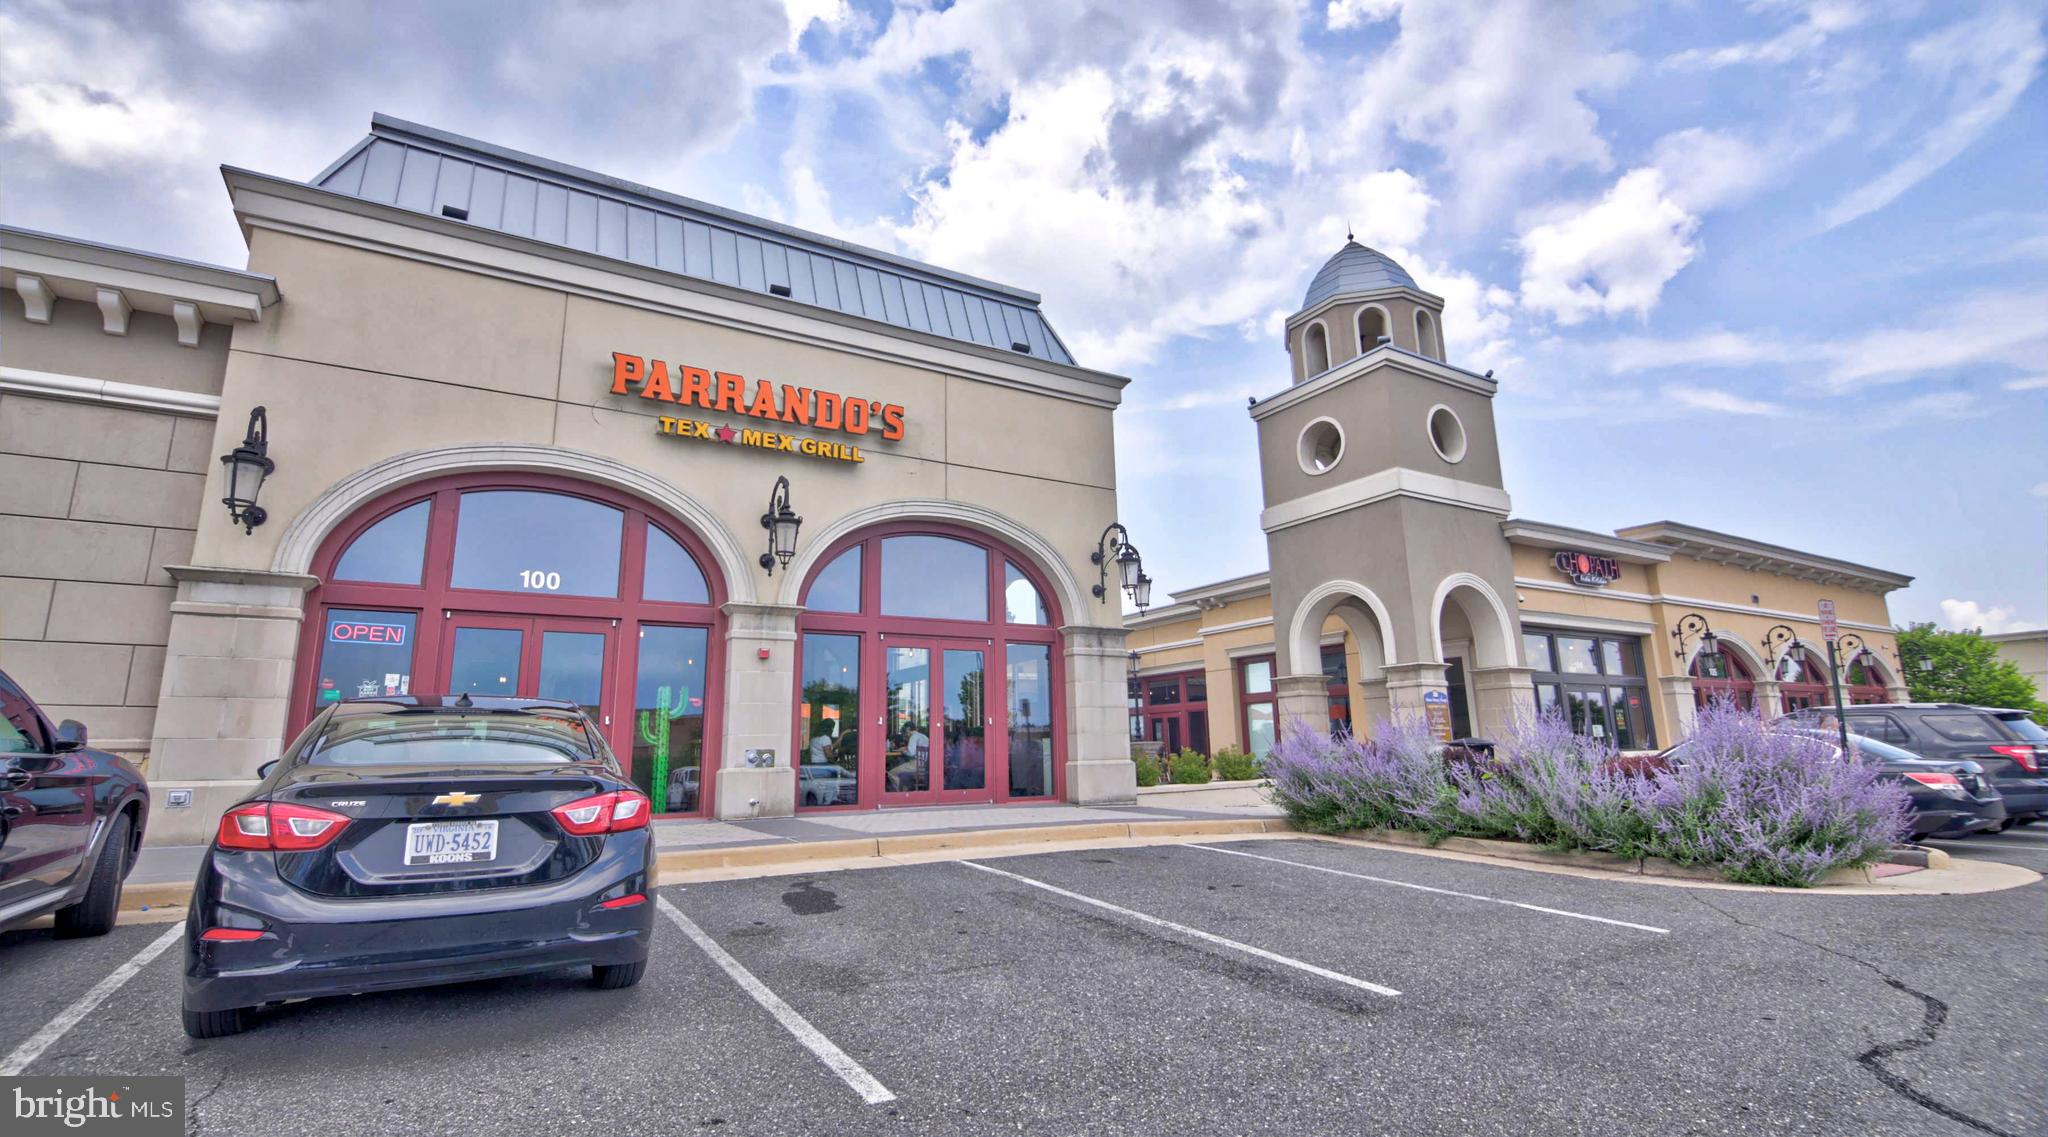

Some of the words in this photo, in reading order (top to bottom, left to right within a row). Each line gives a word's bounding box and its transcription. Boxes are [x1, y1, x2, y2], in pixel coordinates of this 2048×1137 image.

[610, 352, 905, 441] PARRANDO'S
[659, 415, 710, 439] TEX
[742, 428, 795, 452] MEX
[800, 437, 865, 463] GRILL
[520, 570, 561, 590] 100
[333, 624, 403, 642] OPEN
[331, 800, 367, 808] CRUZE
[415, 831, 492, 853] UWD-5452
[430, 853, 473, 864] KOONS
